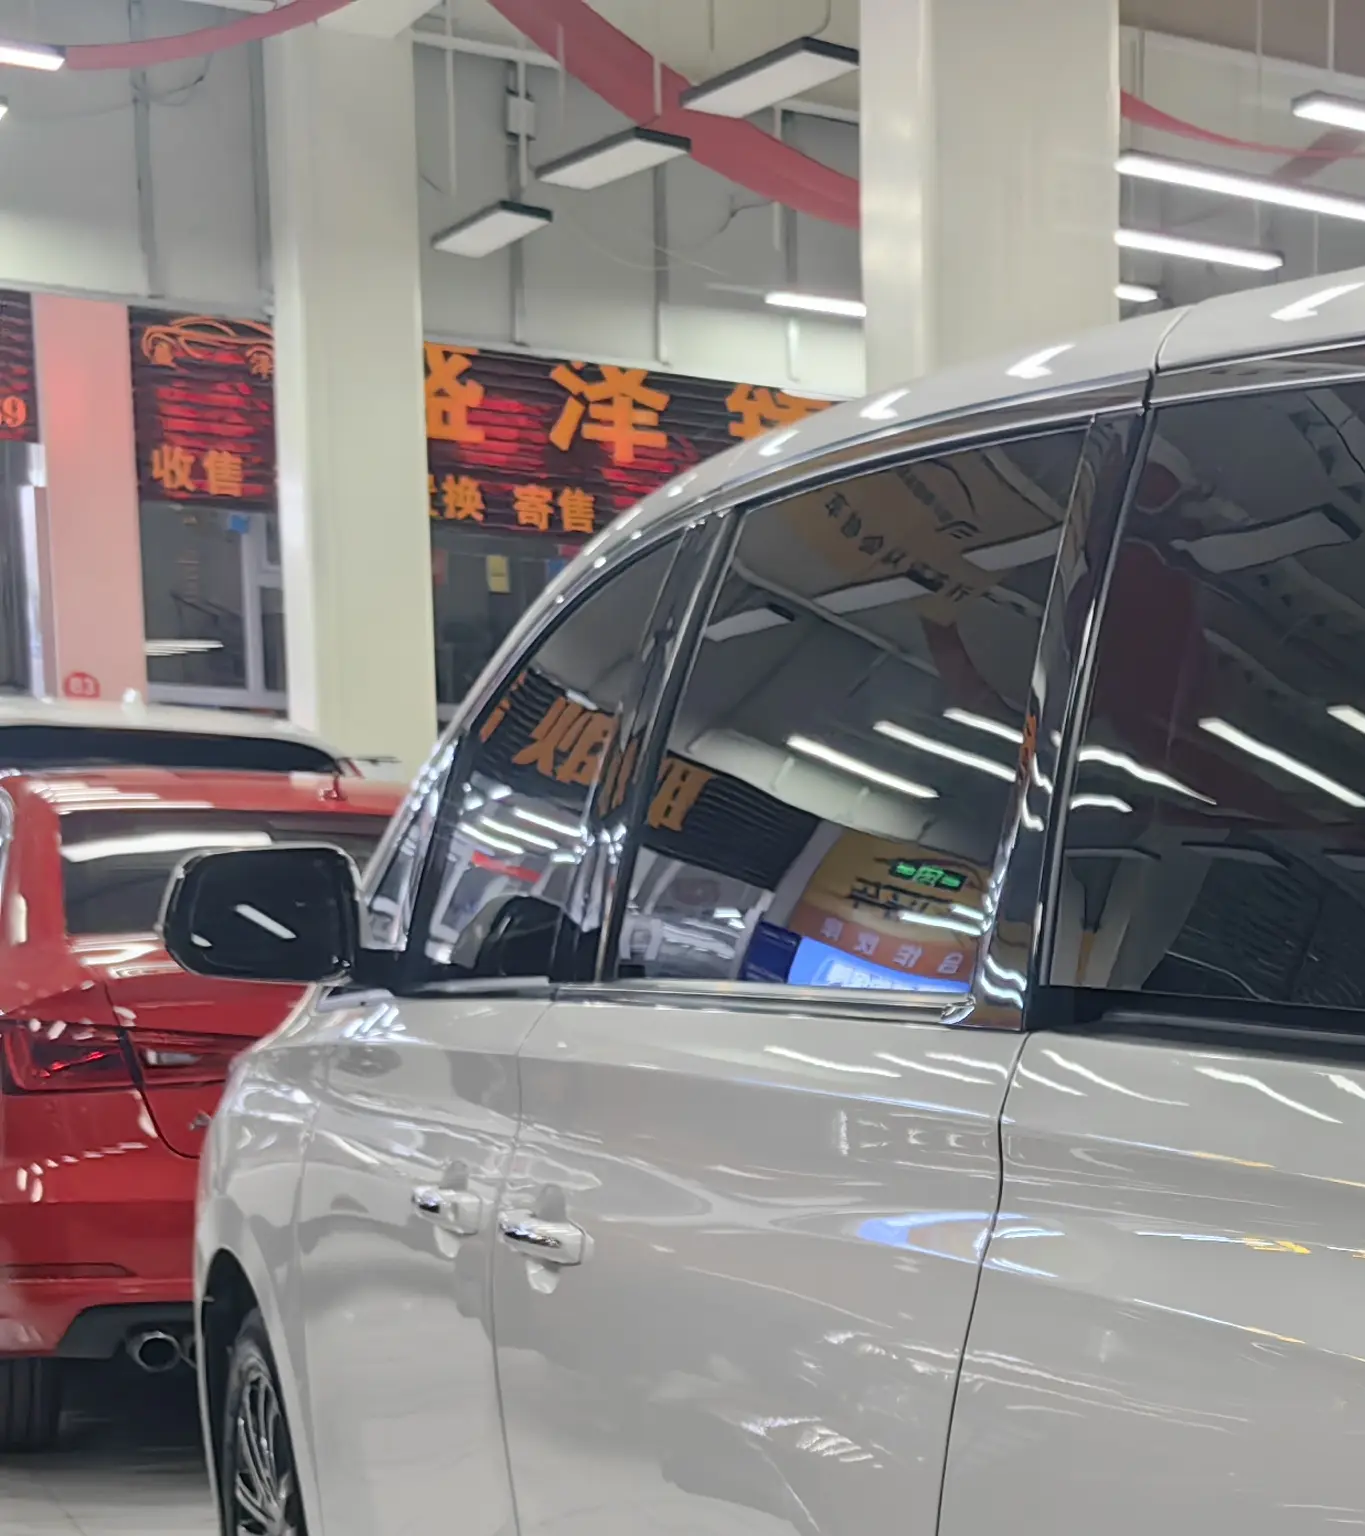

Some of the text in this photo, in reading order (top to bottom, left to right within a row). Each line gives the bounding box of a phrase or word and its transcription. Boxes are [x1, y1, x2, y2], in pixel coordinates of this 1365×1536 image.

[153, 444, 596, 533] 收售 换 寄售
